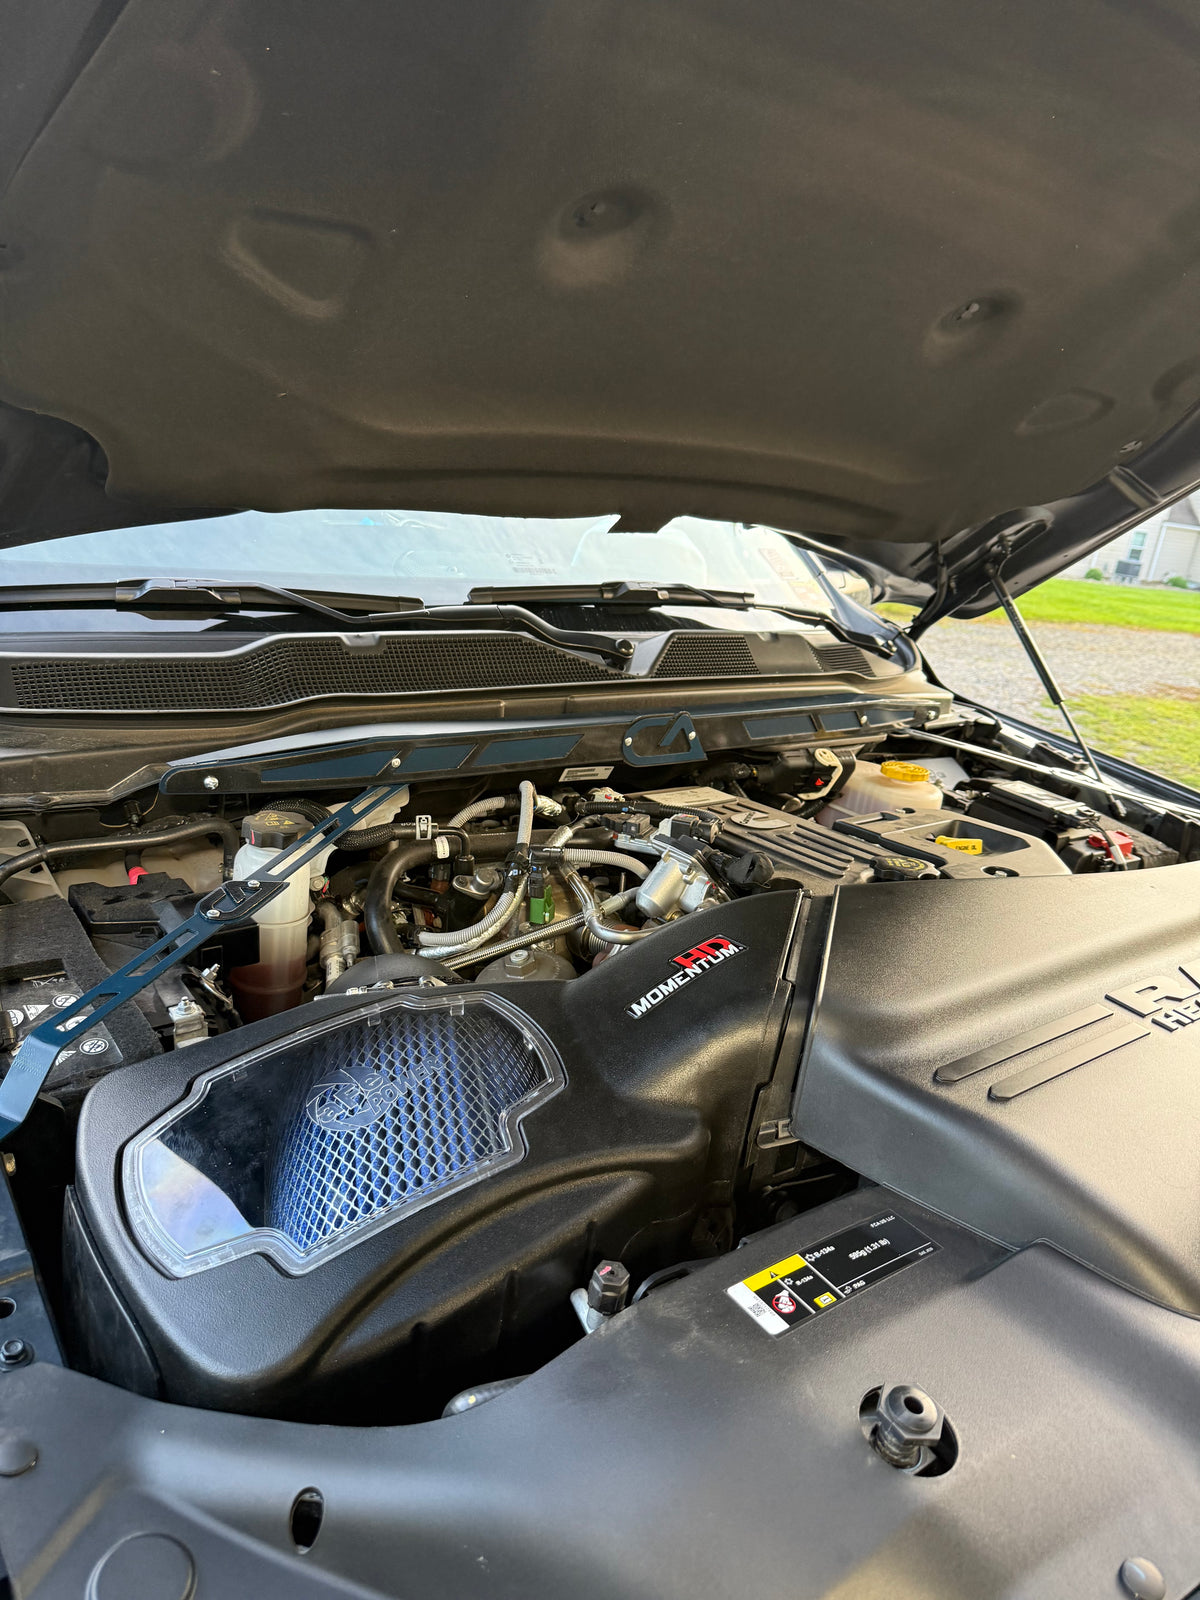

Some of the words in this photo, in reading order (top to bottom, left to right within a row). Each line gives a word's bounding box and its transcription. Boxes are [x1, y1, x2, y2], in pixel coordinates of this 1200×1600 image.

[630, 943, 741, 1018] MOMENTUM
[673, 938, 732, 969] HD
[366, 1056, 445, 1116] POWER
